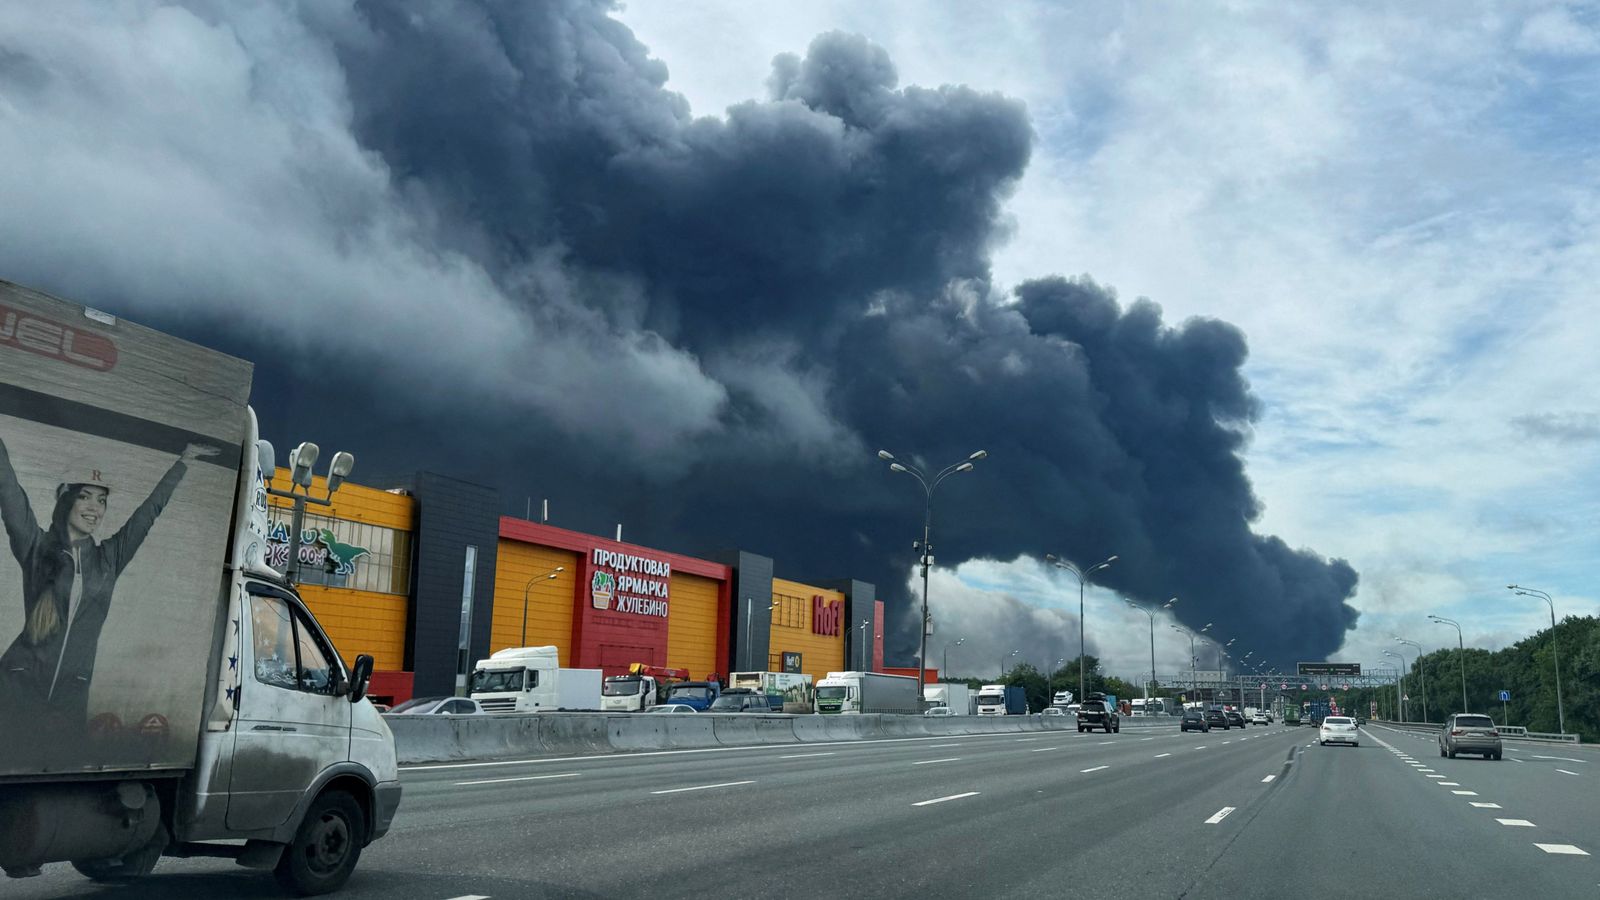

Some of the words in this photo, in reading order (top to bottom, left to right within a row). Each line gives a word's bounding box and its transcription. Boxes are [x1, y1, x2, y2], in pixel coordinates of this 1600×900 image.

[92, 469, 103, 481] R
[593, 548, 670, 577] ПРОДУКТОВАЯ
[617, 575, 668, 598] ЯРМАРКА
[616, 595, 668, 617] ЖУЛЕБИНО
